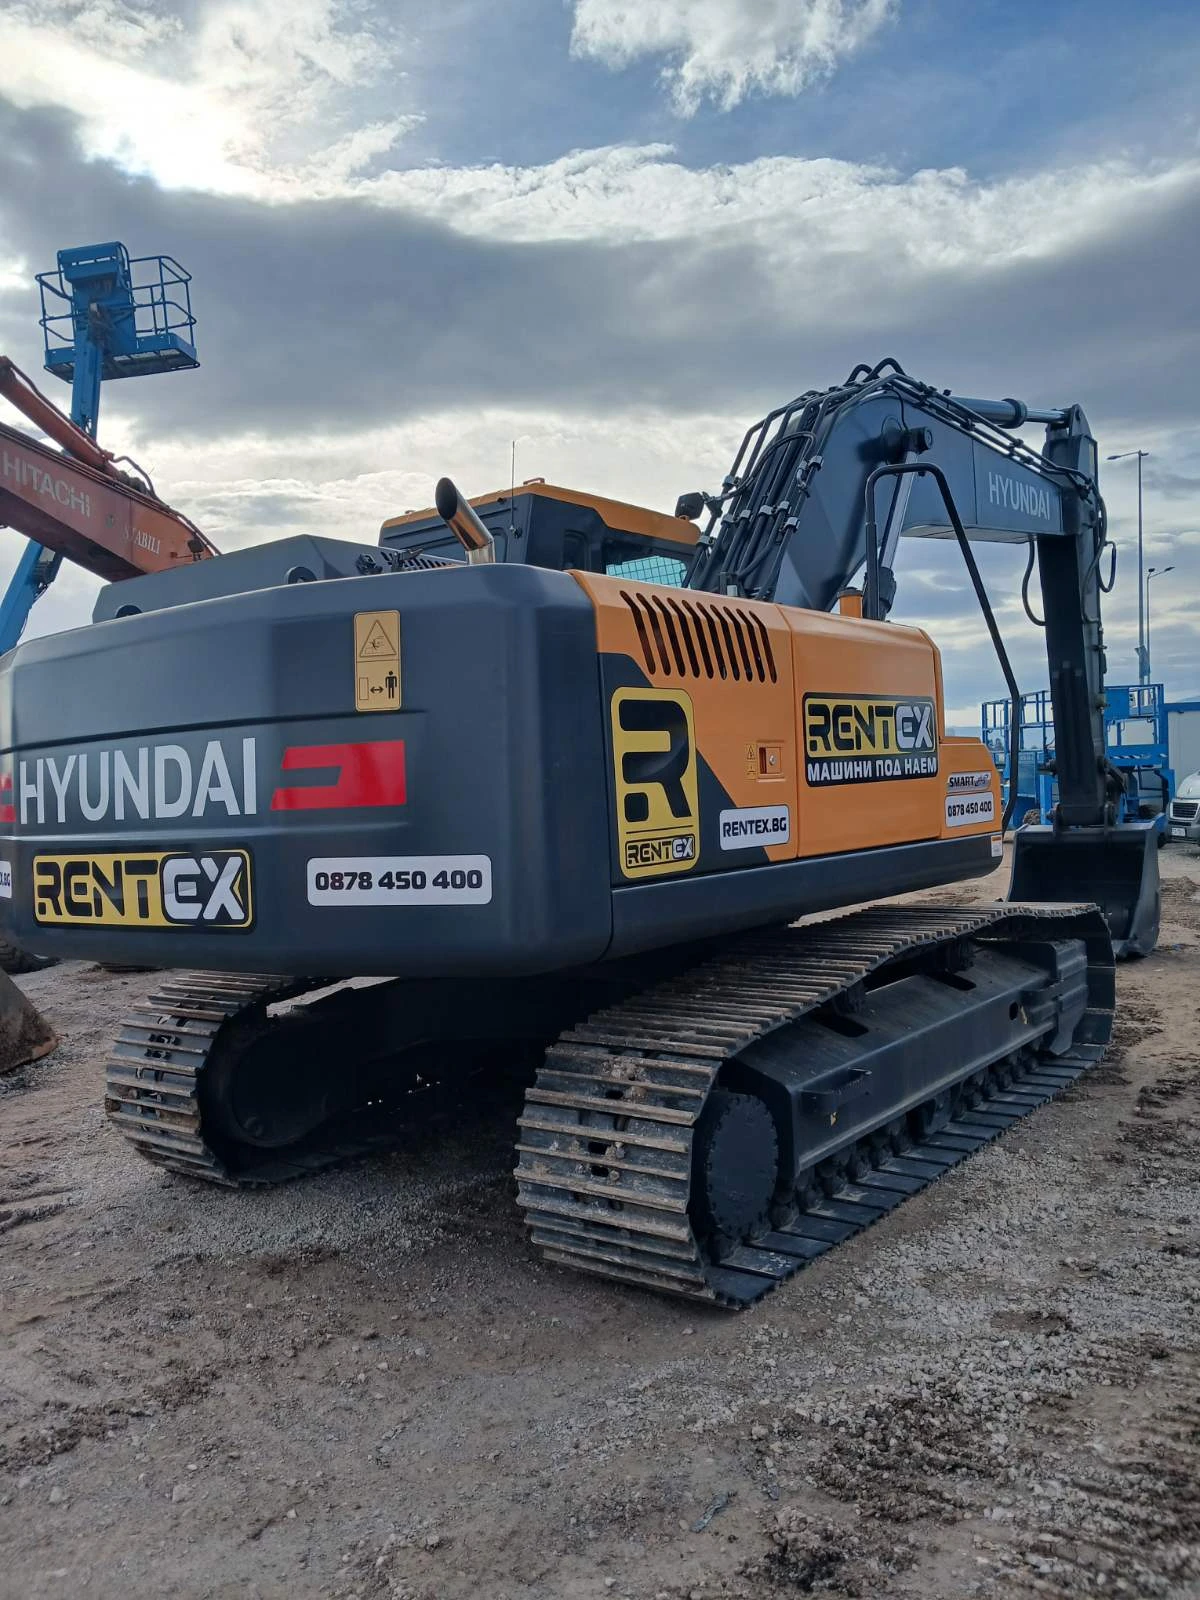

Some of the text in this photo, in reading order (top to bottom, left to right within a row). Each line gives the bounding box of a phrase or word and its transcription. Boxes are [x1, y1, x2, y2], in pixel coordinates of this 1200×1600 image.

[3, 451, 91, 518] HITACHI
[988, 471, 1051, 521] HYUNDAI
[808, 704, 934, 752] RENTEX
[19, 737, 257, 825] HYUNDAI
[807, 757, 937, 782] МАШИНИ ПОД НАЕМ
[949, 776, 975, 787] SMART
[948, 801, 992, 817] 0878 450 400
[722, 817, 787, 838] RENTEX.BG
[627, 836, 694, 864] RENTEX
[36, 856, 246, 921] RENTEX
[315, 869, 483, 891] 0878 450 400
